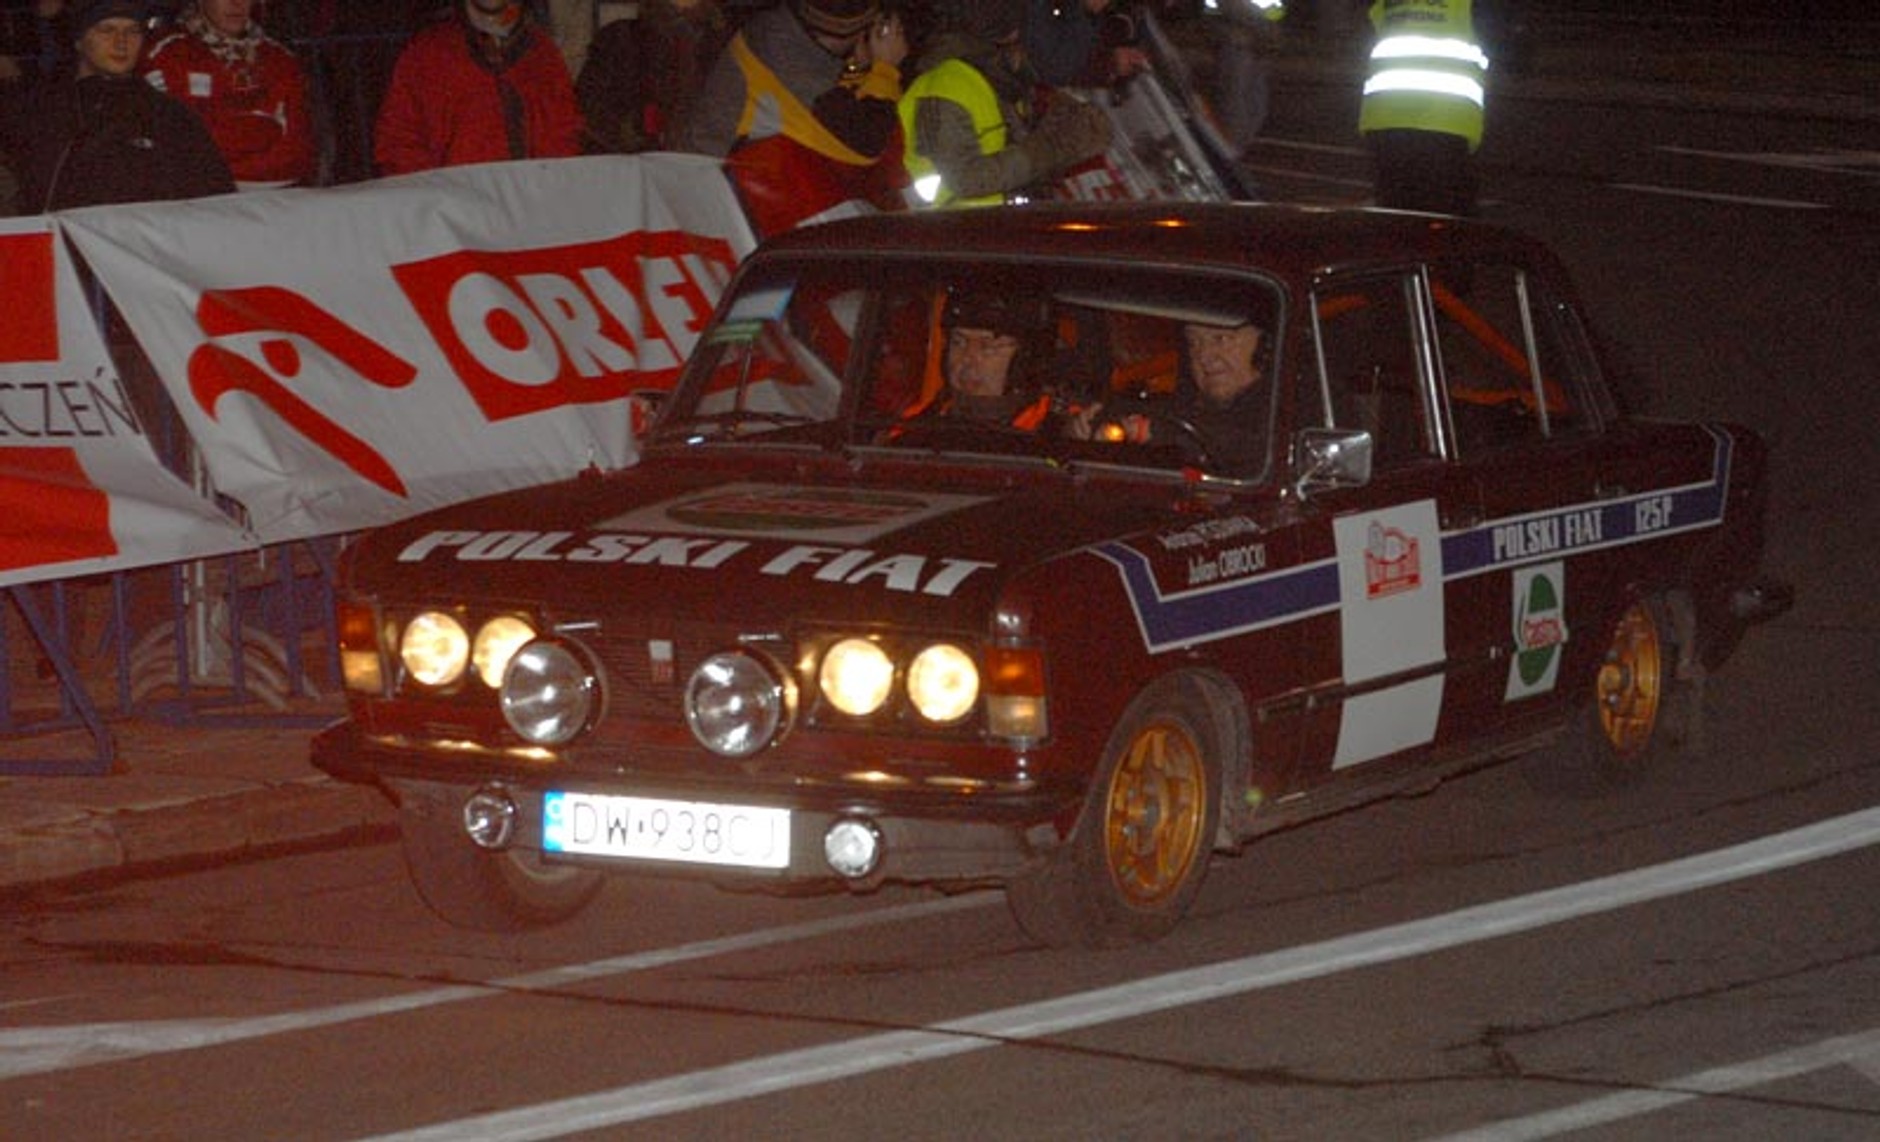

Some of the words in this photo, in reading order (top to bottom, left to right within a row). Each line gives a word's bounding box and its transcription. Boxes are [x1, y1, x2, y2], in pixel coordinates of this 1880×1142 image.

[0, 366, 141, 436] CZEŃ
[397, 531, 750, 568] POLSKI
[760, 545, 997, 596] FIAT
[1493, 515, 1561, 561] POLSKI
[1564, 510, 1604, 547] FIAT
[573, 802, 629, 846] DW
